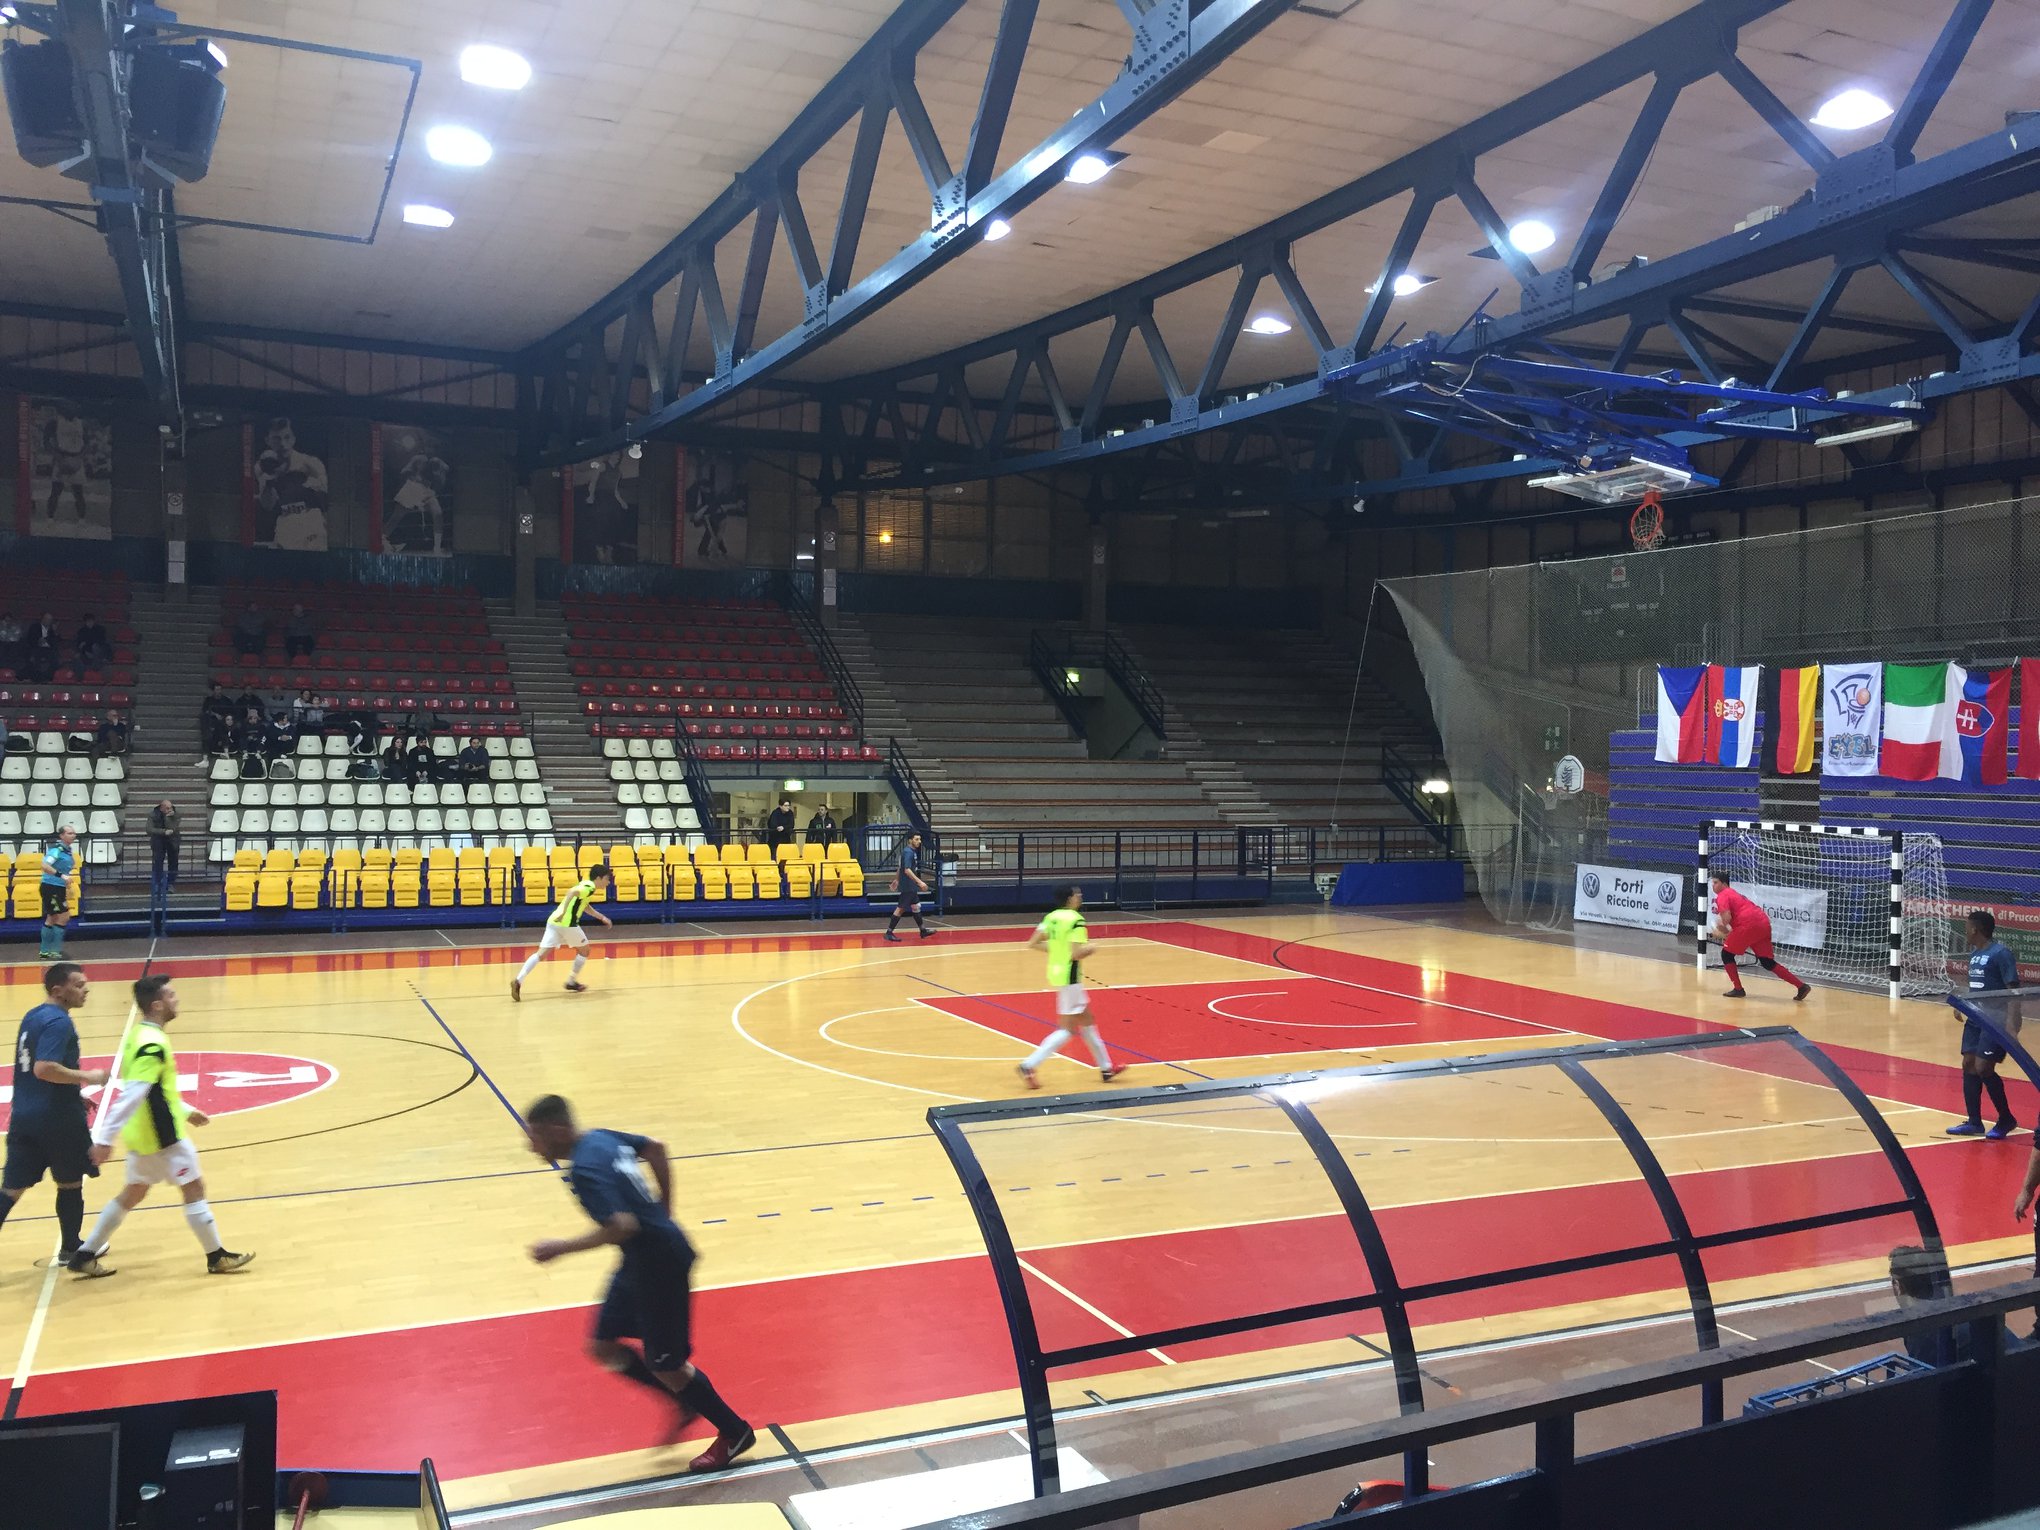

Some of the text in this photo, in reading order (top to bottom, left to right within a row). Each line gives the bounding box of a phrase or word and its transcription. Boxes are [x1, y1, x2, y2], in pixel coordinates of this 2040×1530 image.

[1829, 733, 1877, 759] EYBL
[1614, 878, 1644, 895] Forti
[1606, 894, 1649, 910] Riccione
